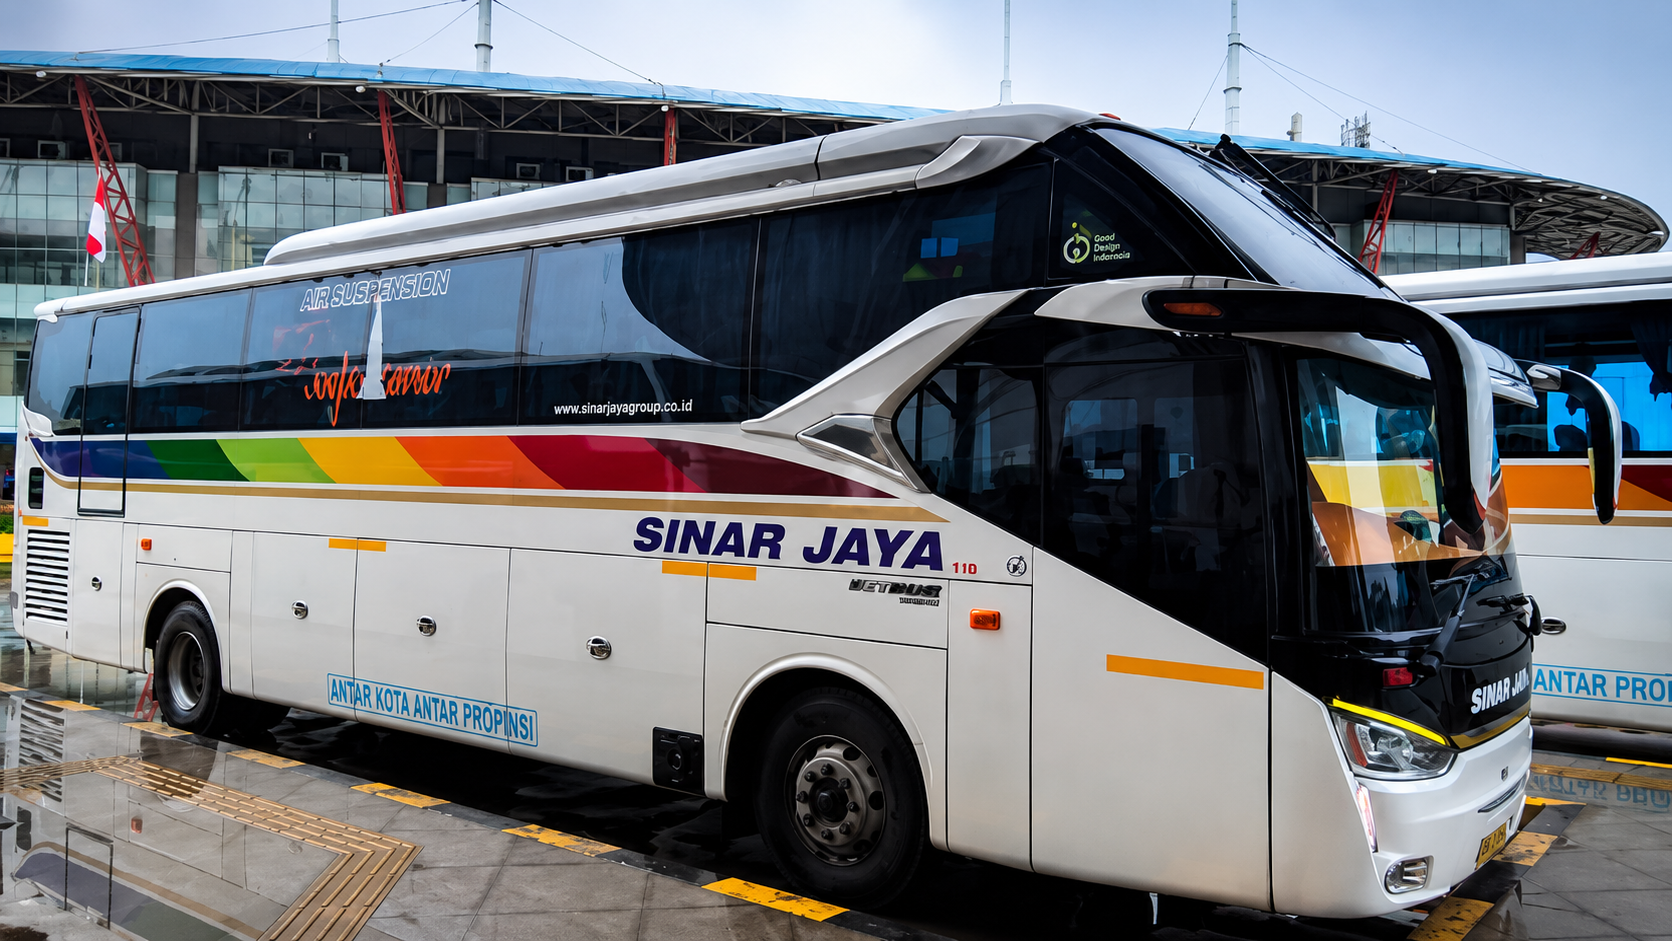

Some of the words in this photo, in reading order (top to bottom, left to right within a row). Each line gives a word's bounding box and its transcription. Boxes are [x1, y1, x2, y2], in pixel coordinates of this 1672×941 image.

[1094, 233, 1115, 242] Good
[1094, 243, 1121, 253] Design
[300, 287, 330, 311] AIR
[331, 269, 451, 308] SUSPENSION
[554, 398, 693, 417] www.sinarjayagroup.co.id
[633, 516, 786, 560] SINAR
[802, 526, 944, 571] JAYA
[1470, 676, 1511, 714] SINAR
[1533, 668, 1607, 698] ANTAR
[1615, 675, 1672, 703] PRO
[331, 678, 372, 709] ANTAR
[375, 686, 411, 717] KOTA
[413, 694, 459, 726] ANTAR
[463, 702, 534, 742] PROPINSI
